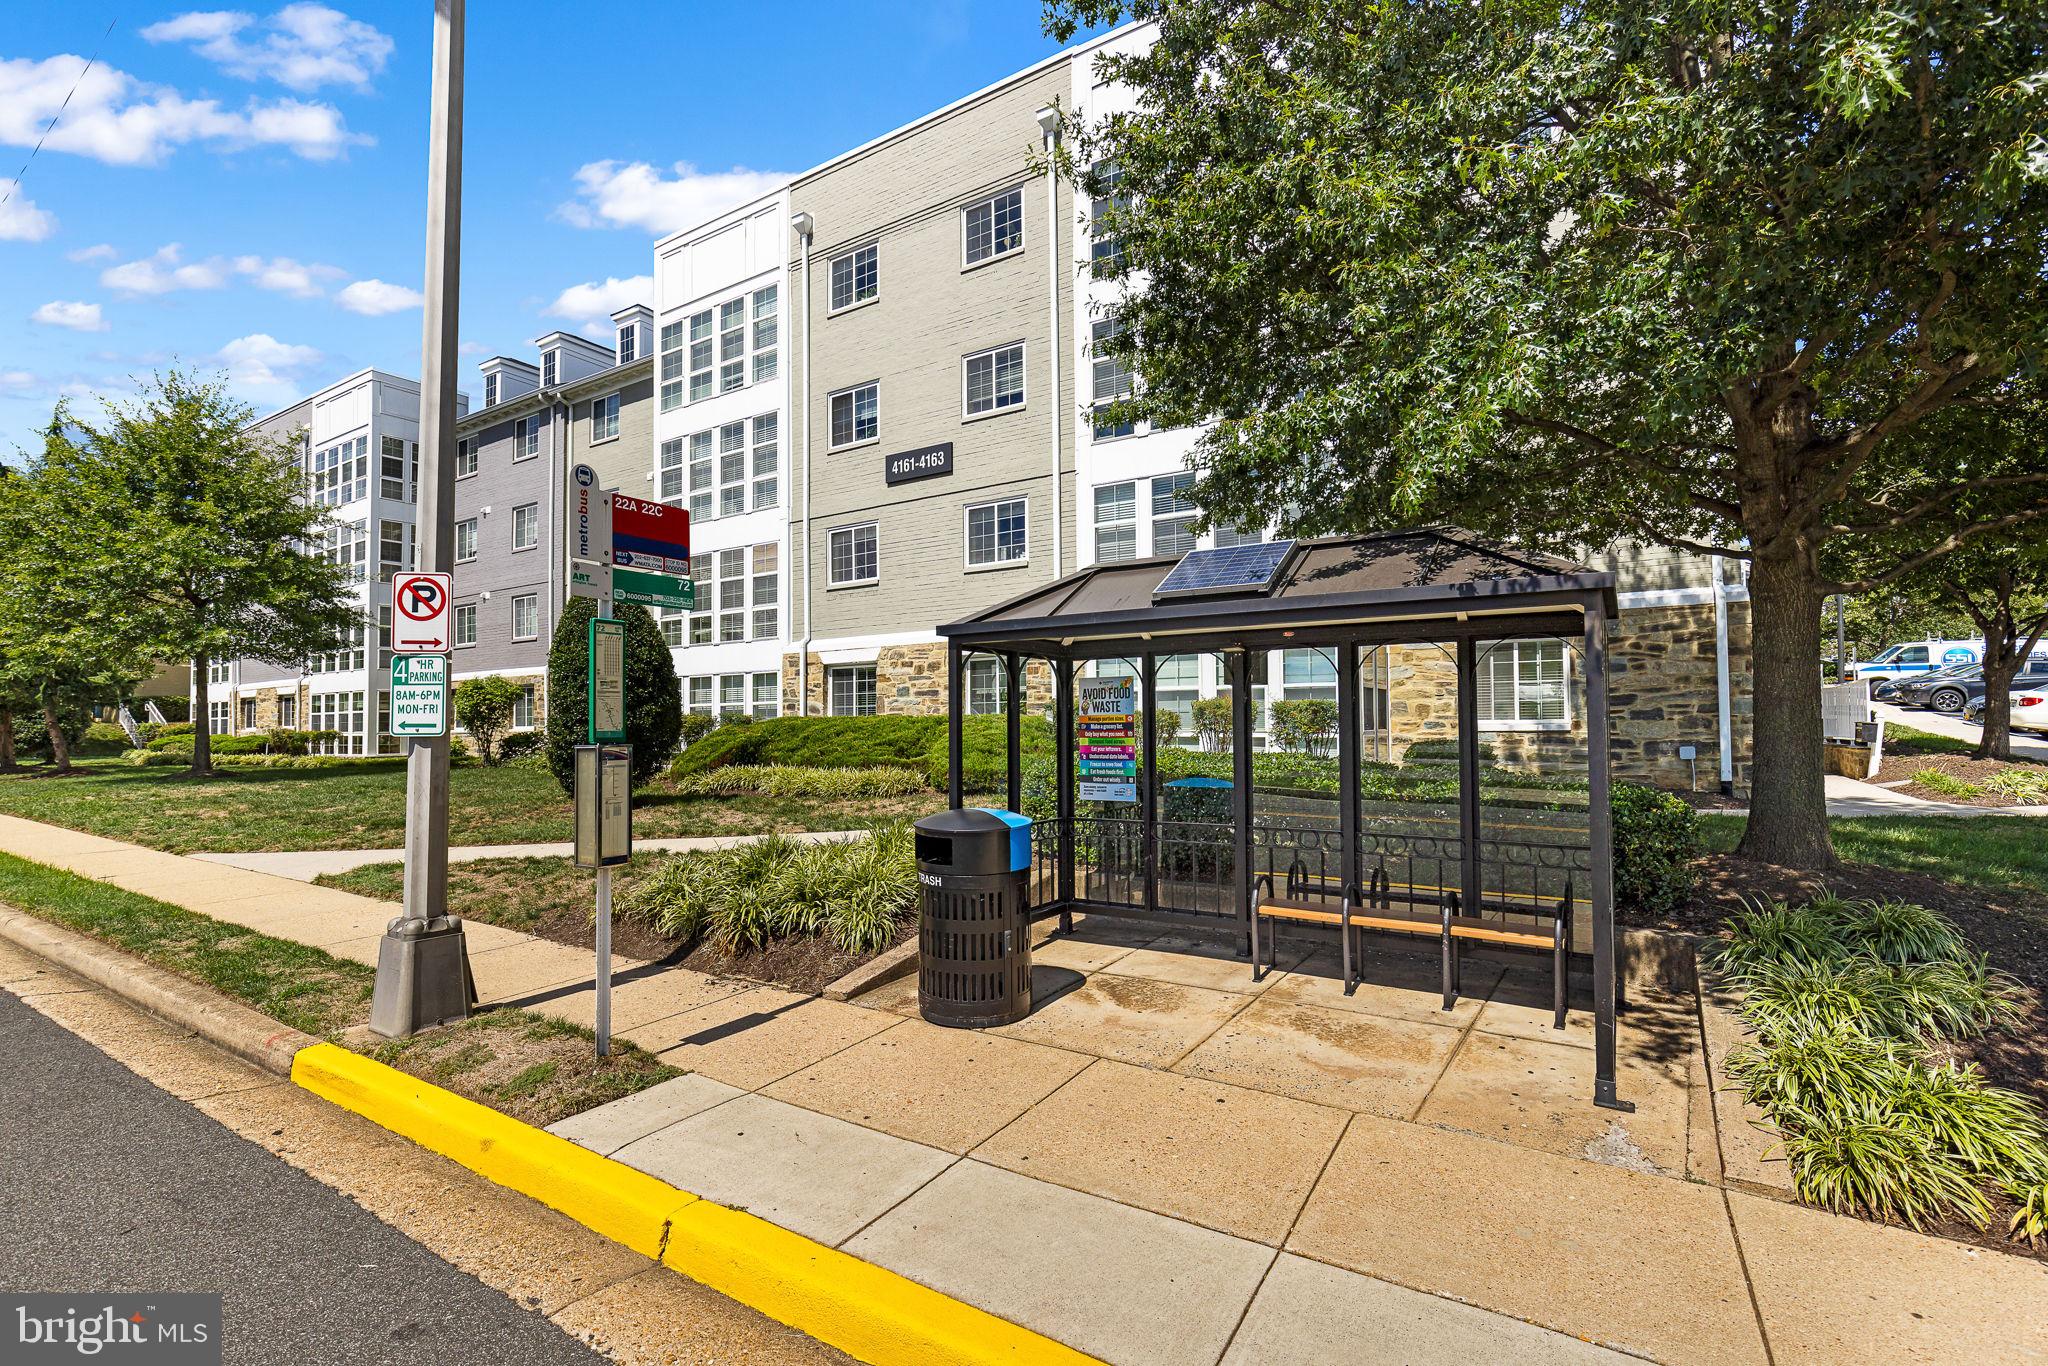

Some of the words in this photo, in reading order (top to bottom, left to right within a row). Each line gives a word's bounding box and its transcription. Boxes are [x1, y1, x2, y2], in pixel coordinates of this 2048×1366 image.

[892, 451, 945, 474] 4161-4163
[615, 497, 637, 512] 22A
[641, 503, 663, 517] 22C
[578, 489, 588, 556] metrobus
[572, 572, 591, 581] ART
[677, 580, 690, 591] 72
[627, 592, 652, 602] 6000095
[1945, 654, 1973, 663] SSI
[393, 659, 408, 683] 4
[420, 659, 434, 670] HR
[409, 672, 443, 682] PARKING
[395, 690, 441, 700] 8AM-6PM
[1082, 688, 1106, 700] AVOID
[1108, 687, 1131, 699] FOOD
[397, 704, 439, 714] MON-FRI
[1091, 701, 1121, 713] WASTE
